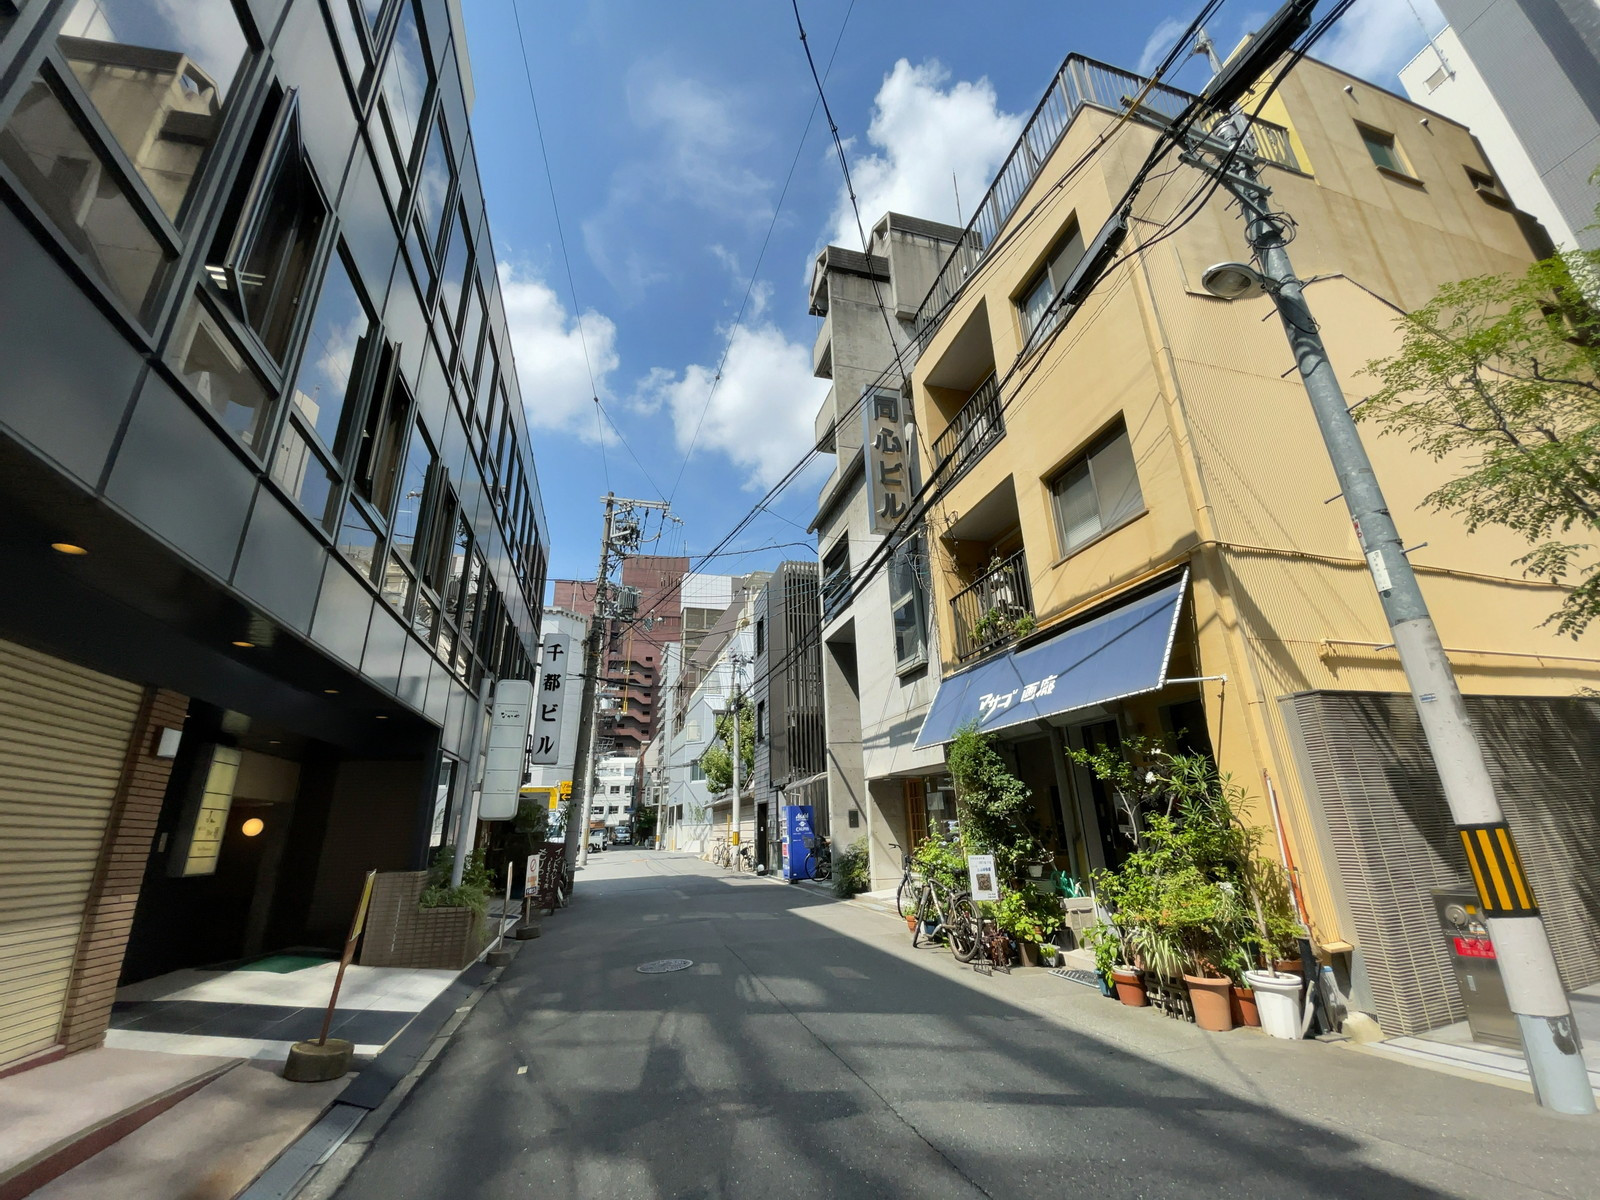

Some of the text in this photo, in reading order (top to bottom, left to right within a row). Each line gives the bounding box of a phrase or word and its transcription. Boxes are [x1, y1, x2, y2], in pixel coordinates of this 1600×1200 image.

[536, 643, 564, 755] 千都ビル
[979, 674, 1059, 722] マサゴ画廊
